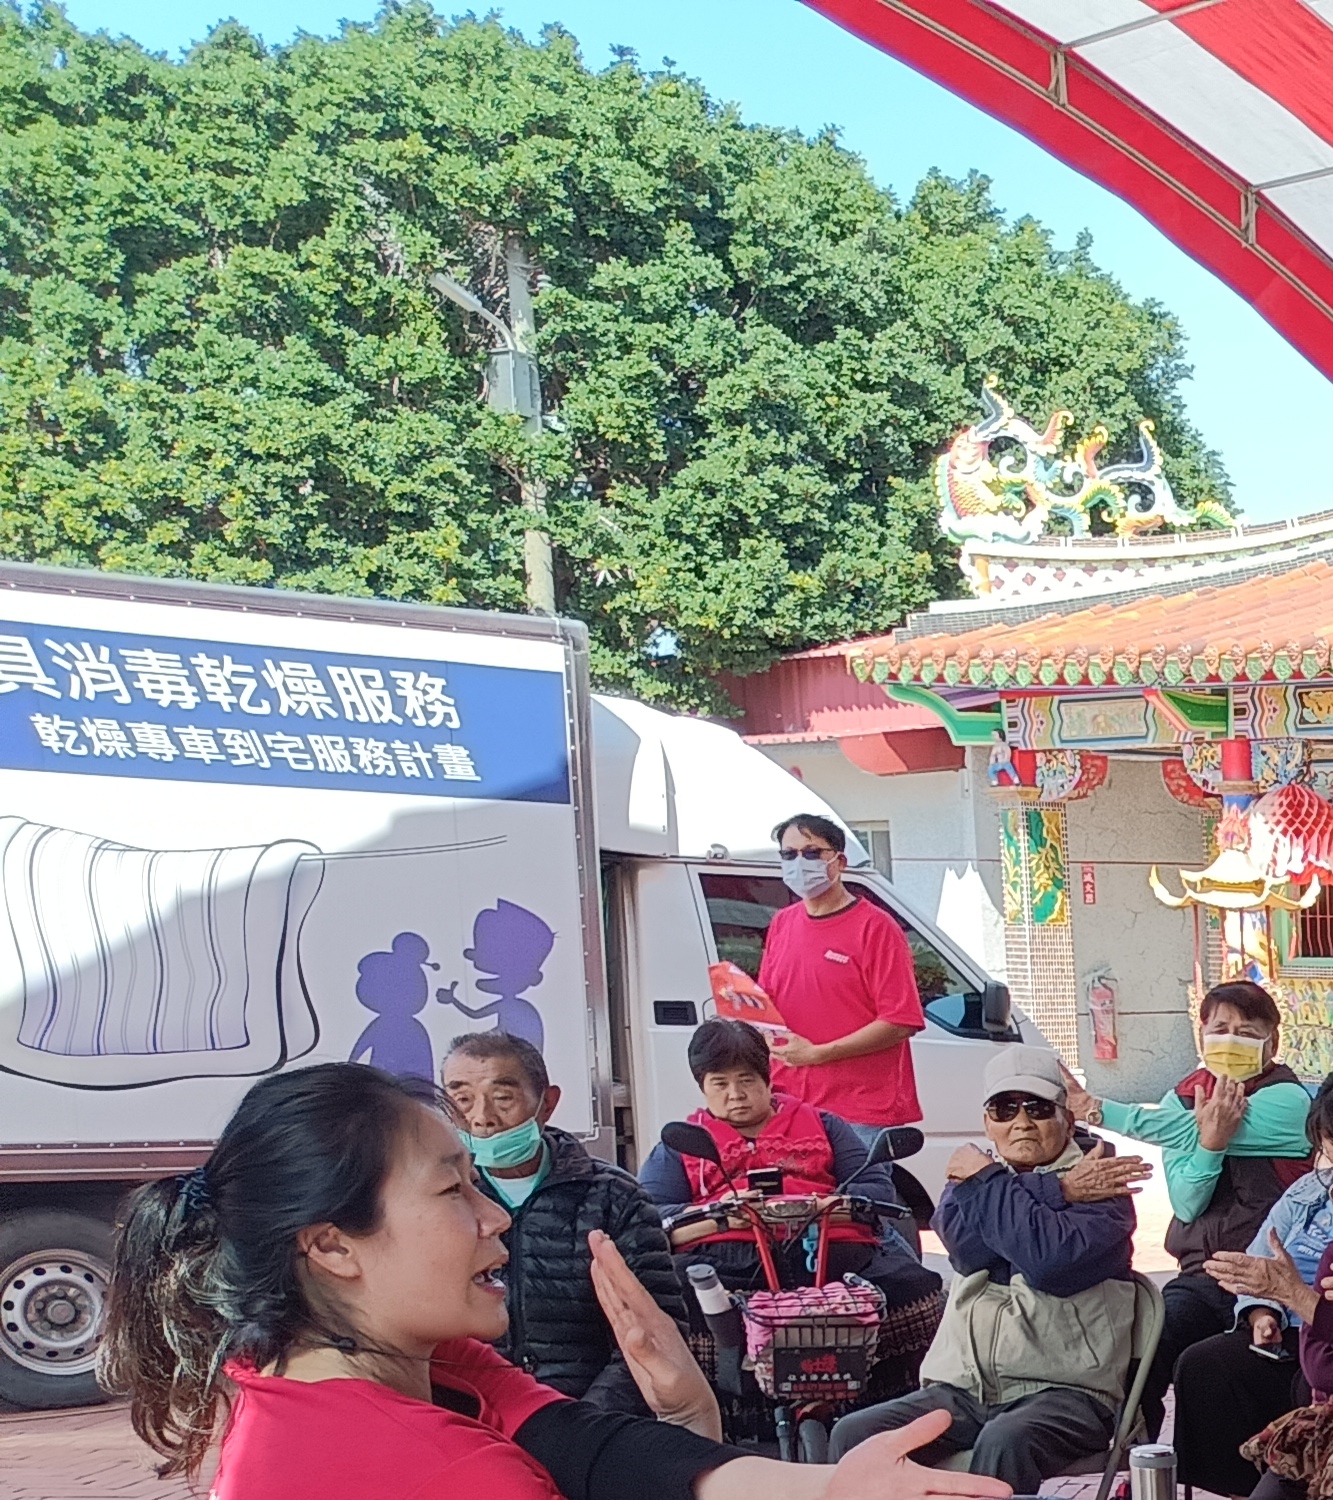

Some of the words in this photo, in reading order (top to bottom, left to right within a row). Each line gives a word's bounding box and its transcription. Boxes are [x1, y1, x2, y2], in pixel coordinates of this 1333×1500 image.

[0, 634, 462, 730] 具消毒乾燥服務
[29, 712, 482, 783] 乾燥專車到宅服務計畫
